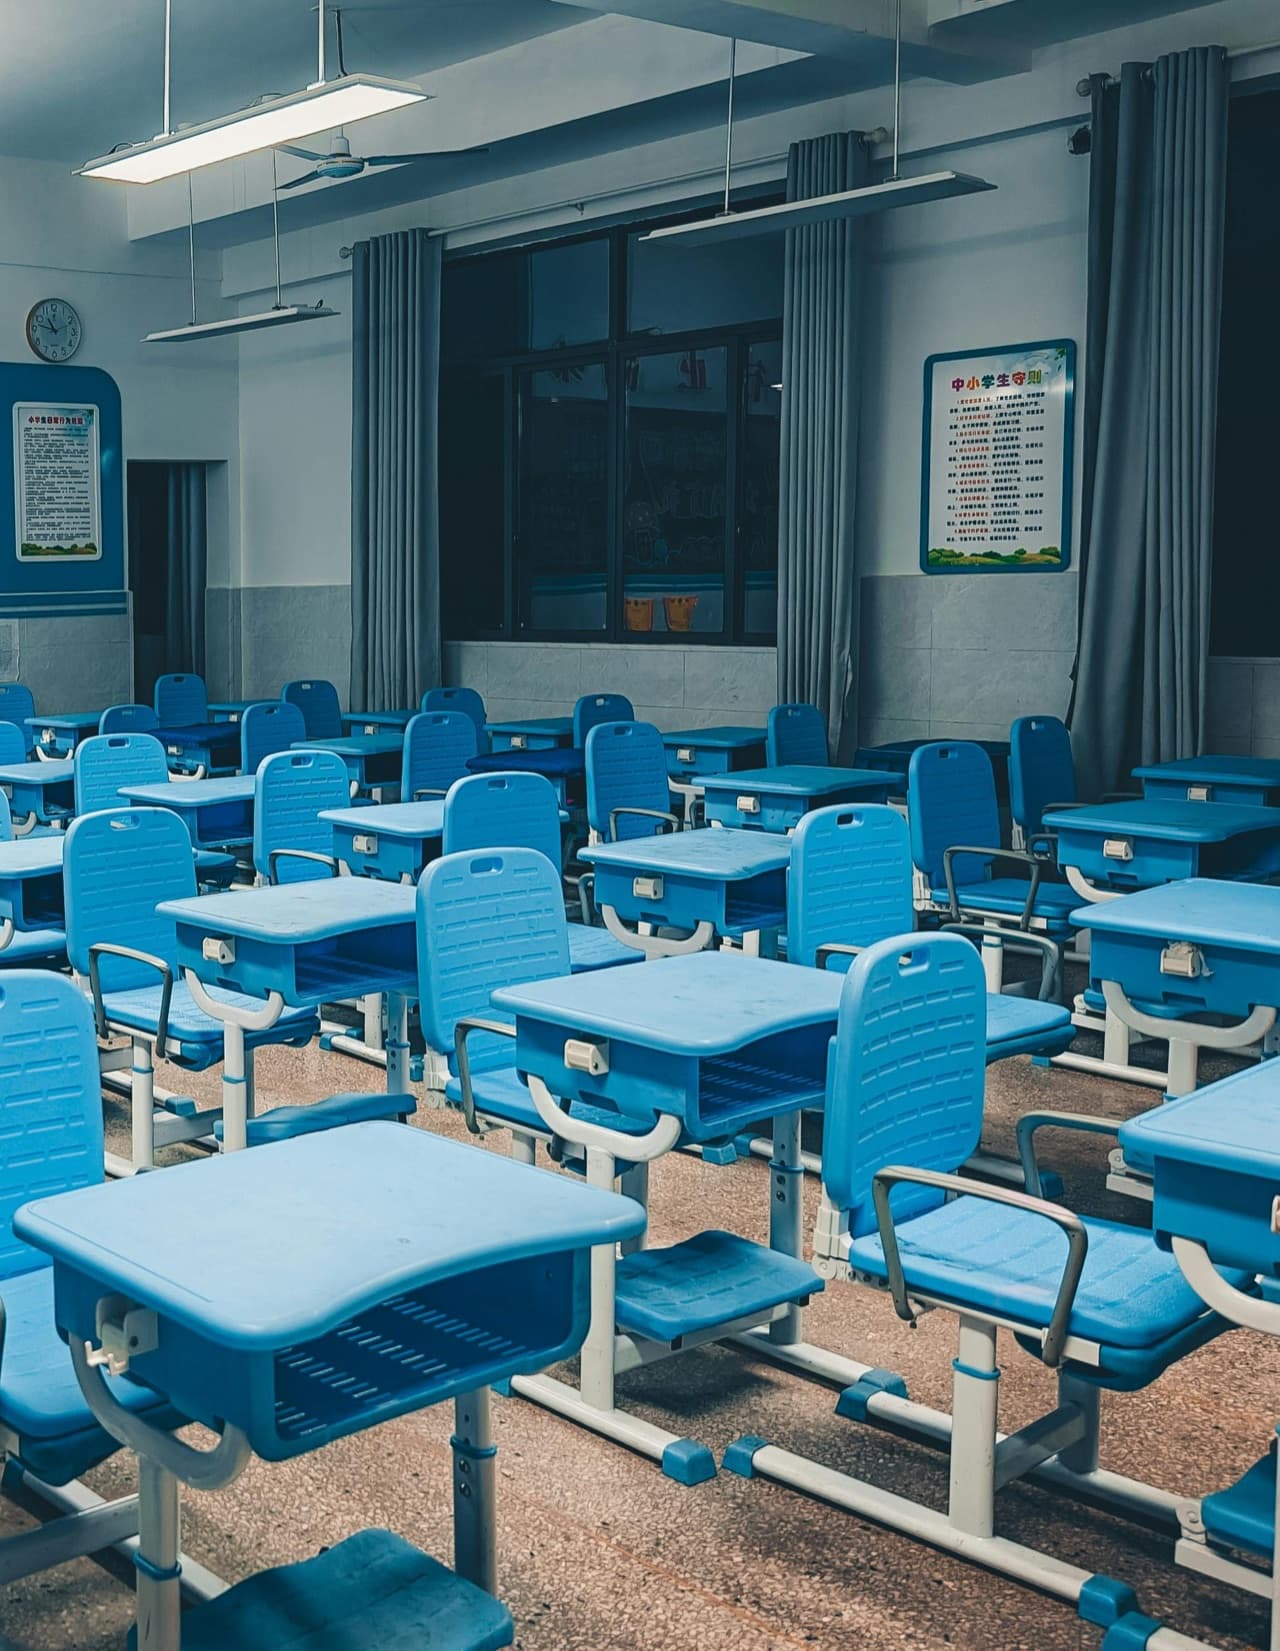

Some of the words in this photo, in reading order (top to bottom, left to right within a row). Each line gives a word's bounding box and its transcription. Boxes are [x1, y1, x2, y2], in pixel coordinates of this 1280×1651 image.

[951, 369, 1042, 392] 中小学生守则
